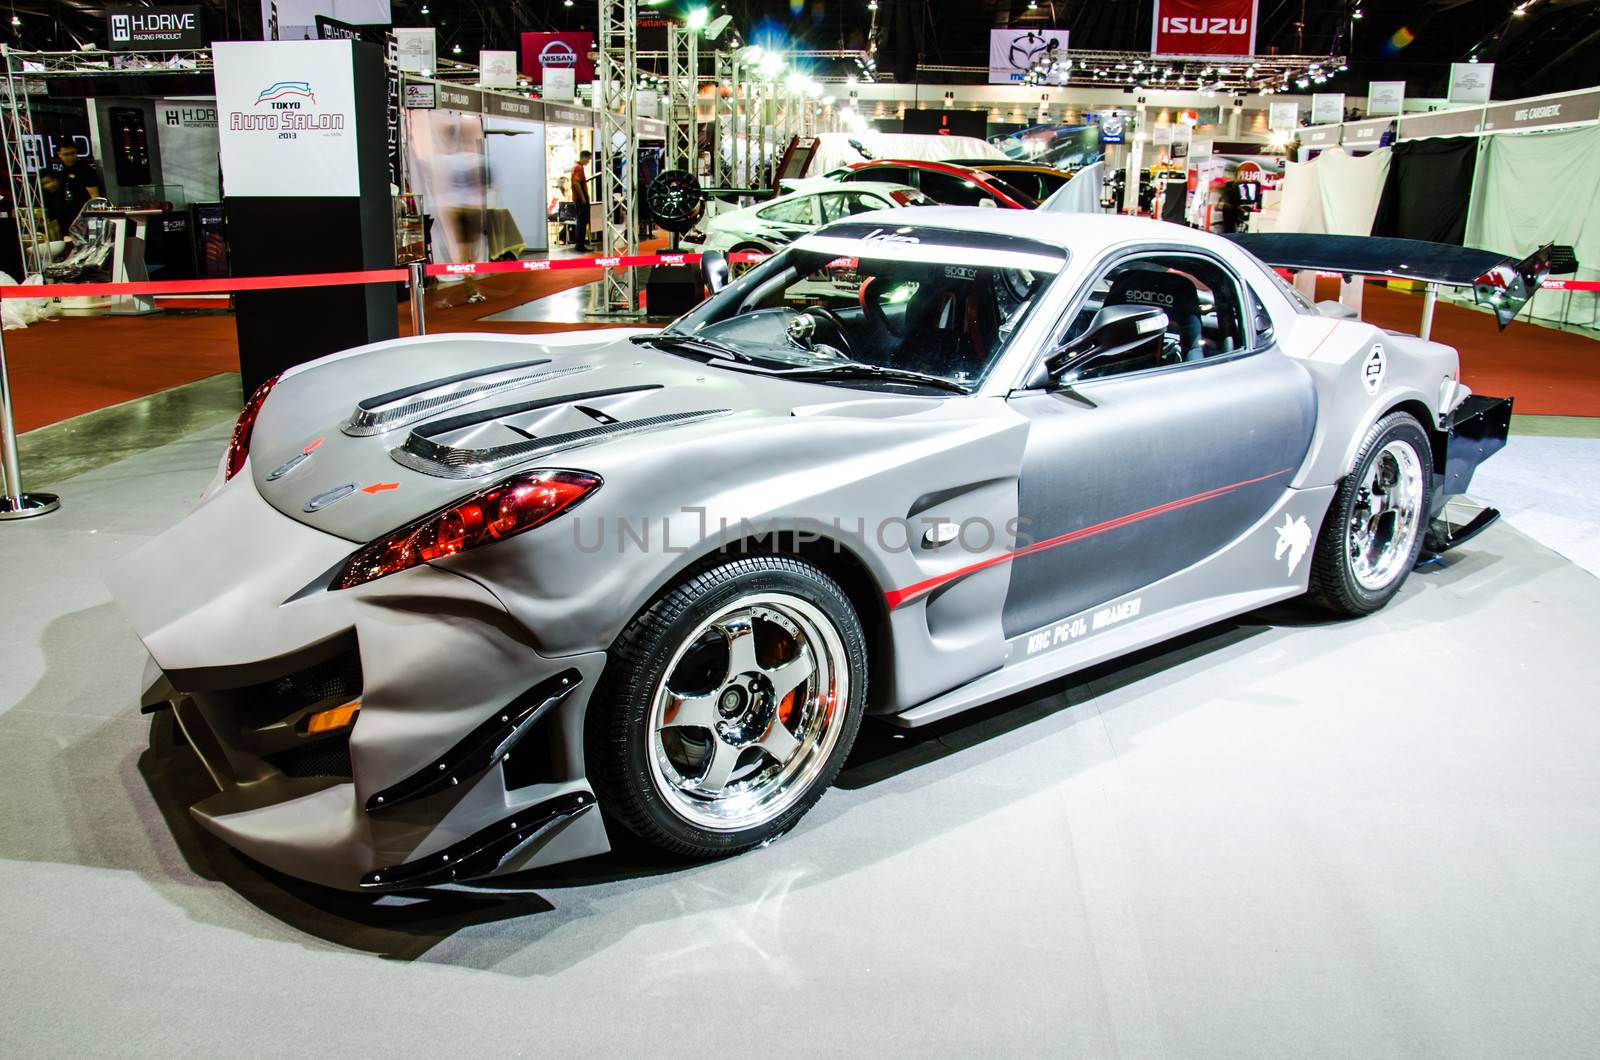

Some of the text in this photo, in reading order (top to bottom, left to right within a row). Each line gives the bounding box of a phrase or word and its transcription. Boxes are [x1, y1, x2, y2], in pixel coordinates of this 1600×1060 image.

[132, 14, 195, 31] H.DRIVE
[1162, 17, 1248, 34] ISUZU
[271, 102, 301, 110] TOKYO
[524, 261, 551, 269] IMPACT
[1125, 289, 1174, 304] sparco
[1027, 630, 1052, 655] KRC
